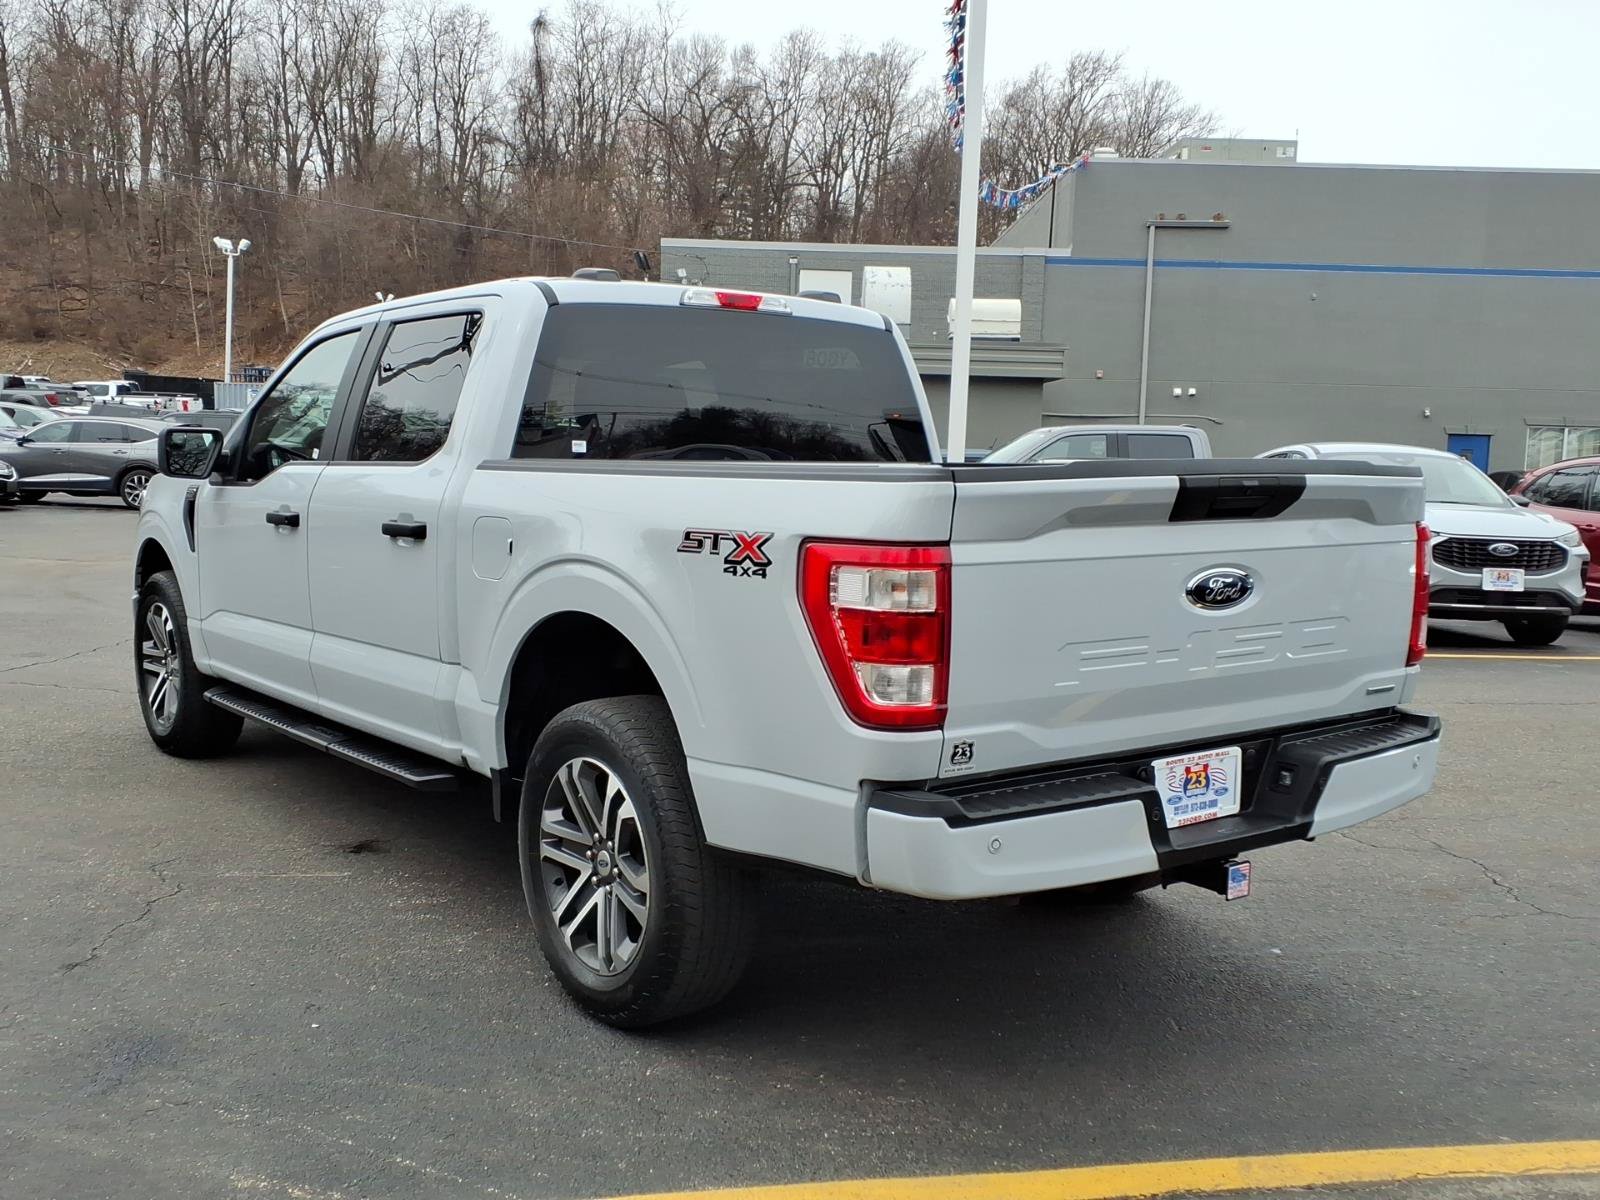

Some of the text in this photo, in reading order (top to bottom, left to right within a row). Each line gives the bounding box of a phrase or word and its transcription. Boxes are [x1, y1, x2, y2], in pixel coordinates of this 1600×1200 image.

[677, 527, 774, 567] STX
[1205, 577, 1242, 601] Ford
[955, 748, 970, 759] 23
[1187, 771, 1207, 790] 23
